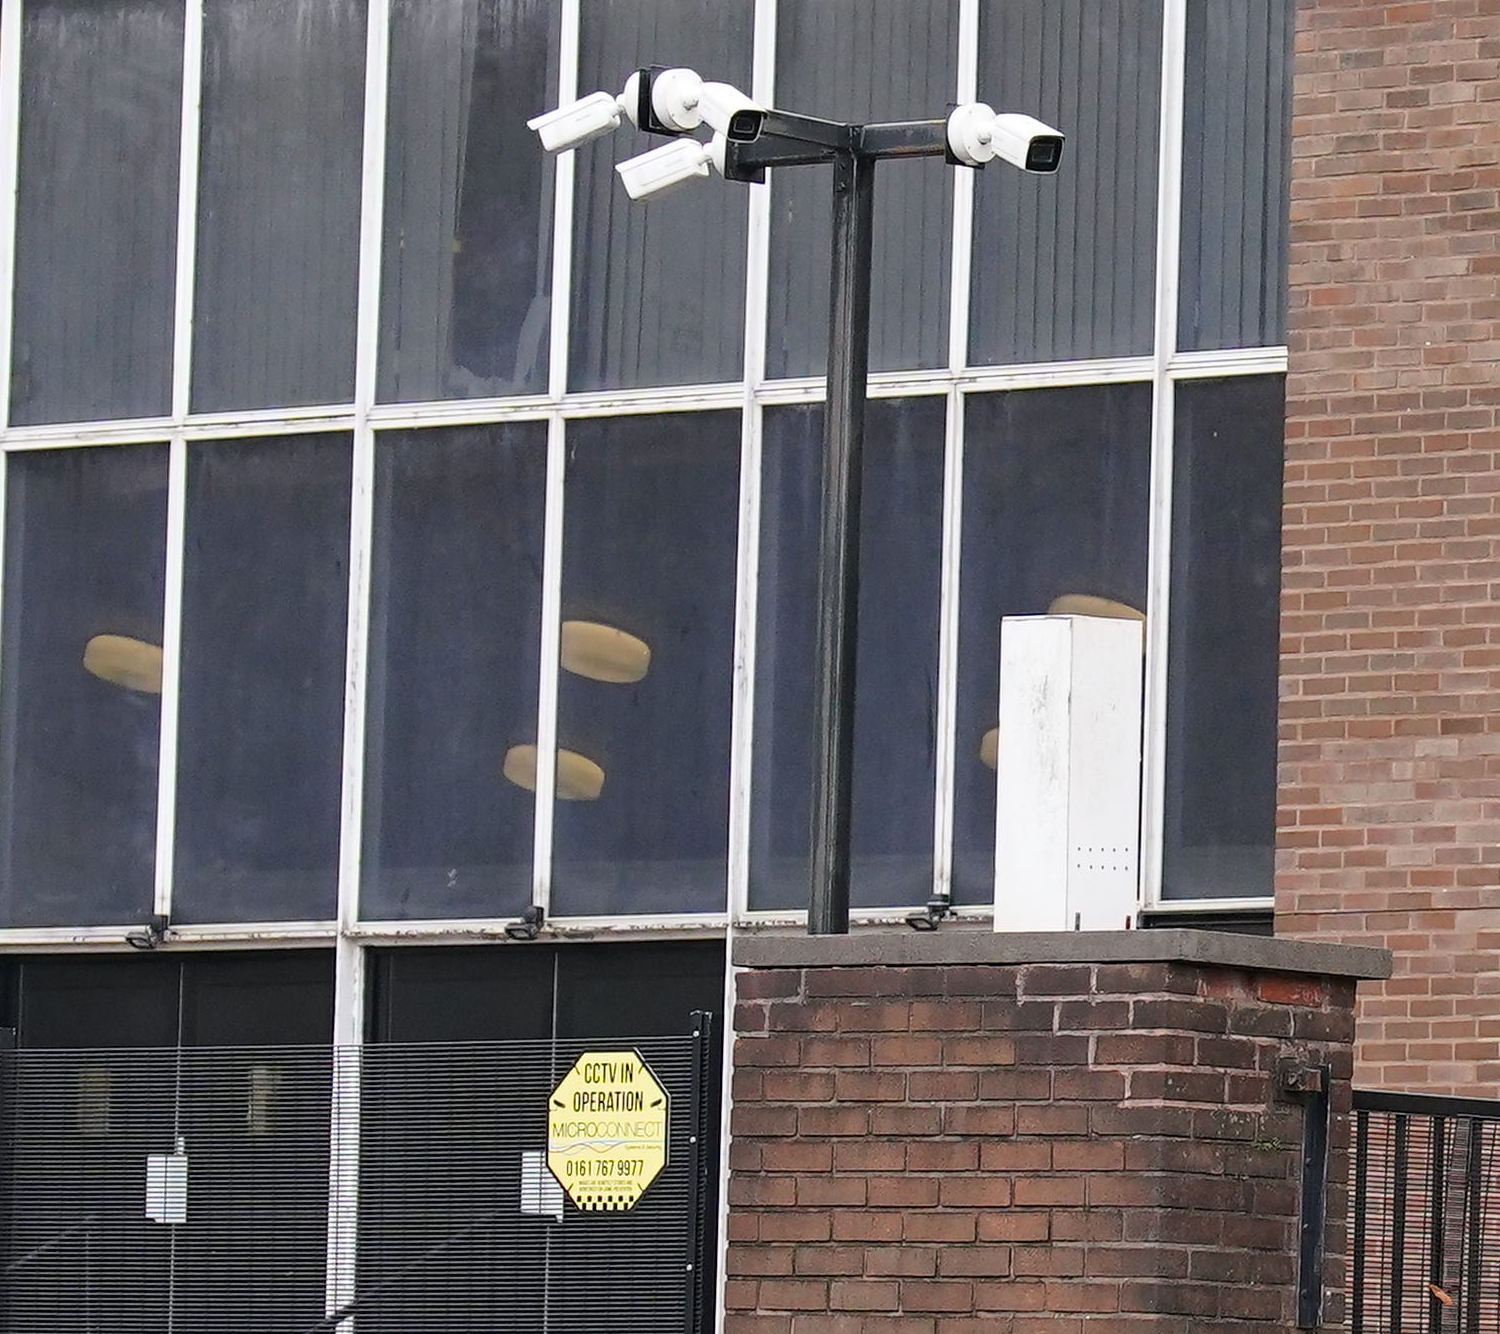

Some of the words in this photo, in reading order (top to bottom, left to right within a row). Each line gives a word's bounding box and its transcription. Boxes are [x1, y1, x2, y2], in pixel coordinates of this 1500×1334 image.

[584, 1062, 617, 1083] CCTV
[620, 1062, 634, 1083] IN
[573, 1091, 644, 1112] OPERATION
[552, 1121, 662, 1138] MICROCONNECT
[566, 1160, 592, 1176] 0161
[596, 1160, 615, 1176] 767
[617, 1160, 644, 1176] 9977
